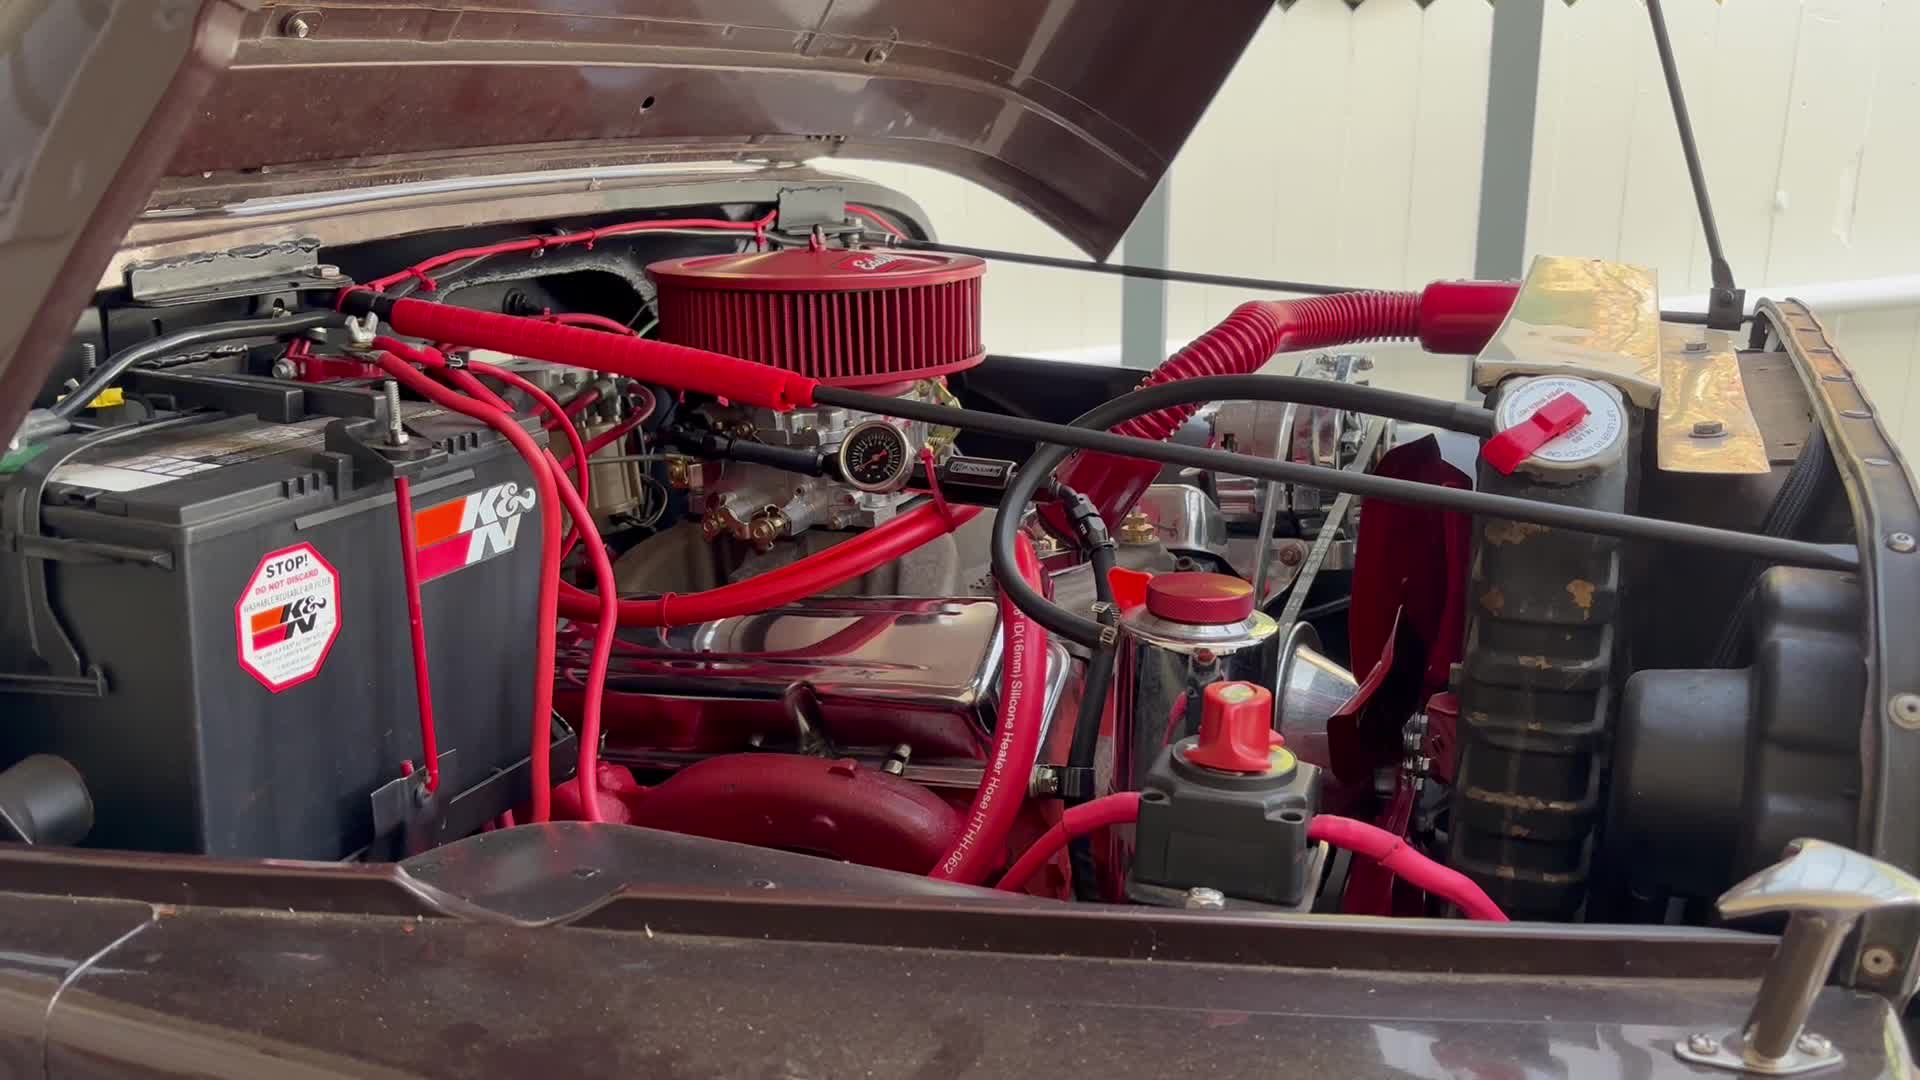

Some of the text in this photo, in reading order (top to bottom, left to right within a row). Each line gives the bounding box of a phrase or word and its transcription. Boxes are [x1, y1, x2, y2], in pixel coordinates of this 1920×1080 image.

[255, 568, 319, 596] DO NOT DISCARD
[266, 554, 308, 578] STOP!
[1004, 680, 1023, 729] Silicone
[992, 731, 1015, 776] Heater
[979, 776, 1001, 810] Hose
[943, 810, 987, 875] HTHH-062
